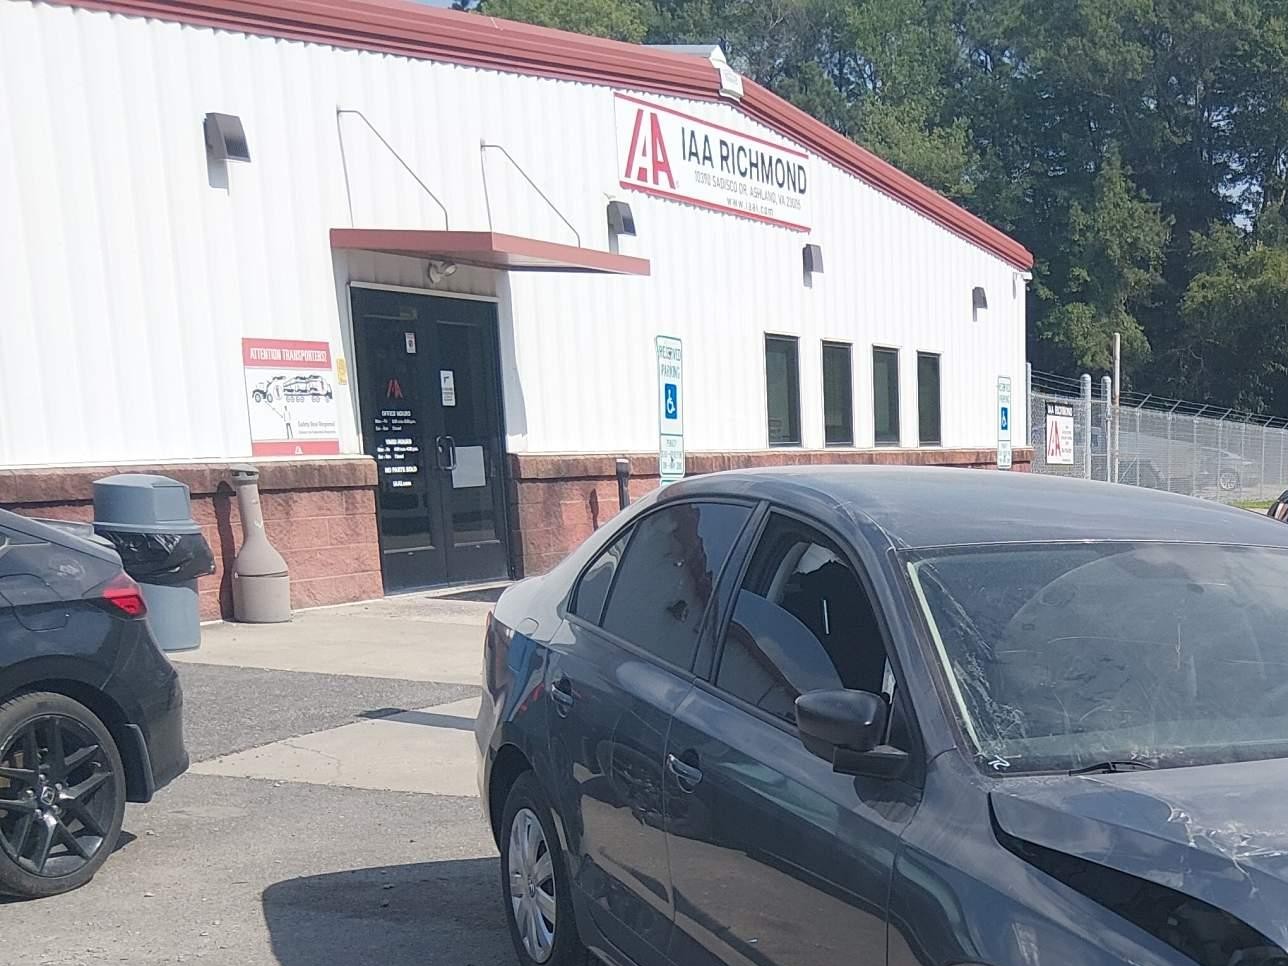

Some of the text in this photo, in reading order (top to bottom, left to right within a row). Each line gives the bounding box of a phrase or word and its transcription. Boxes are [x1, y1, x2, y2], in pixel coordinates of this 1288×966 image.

[681, 126, 808, 195] IAA RICHMOND
[250, 347, 282, 361] ATTENTION
